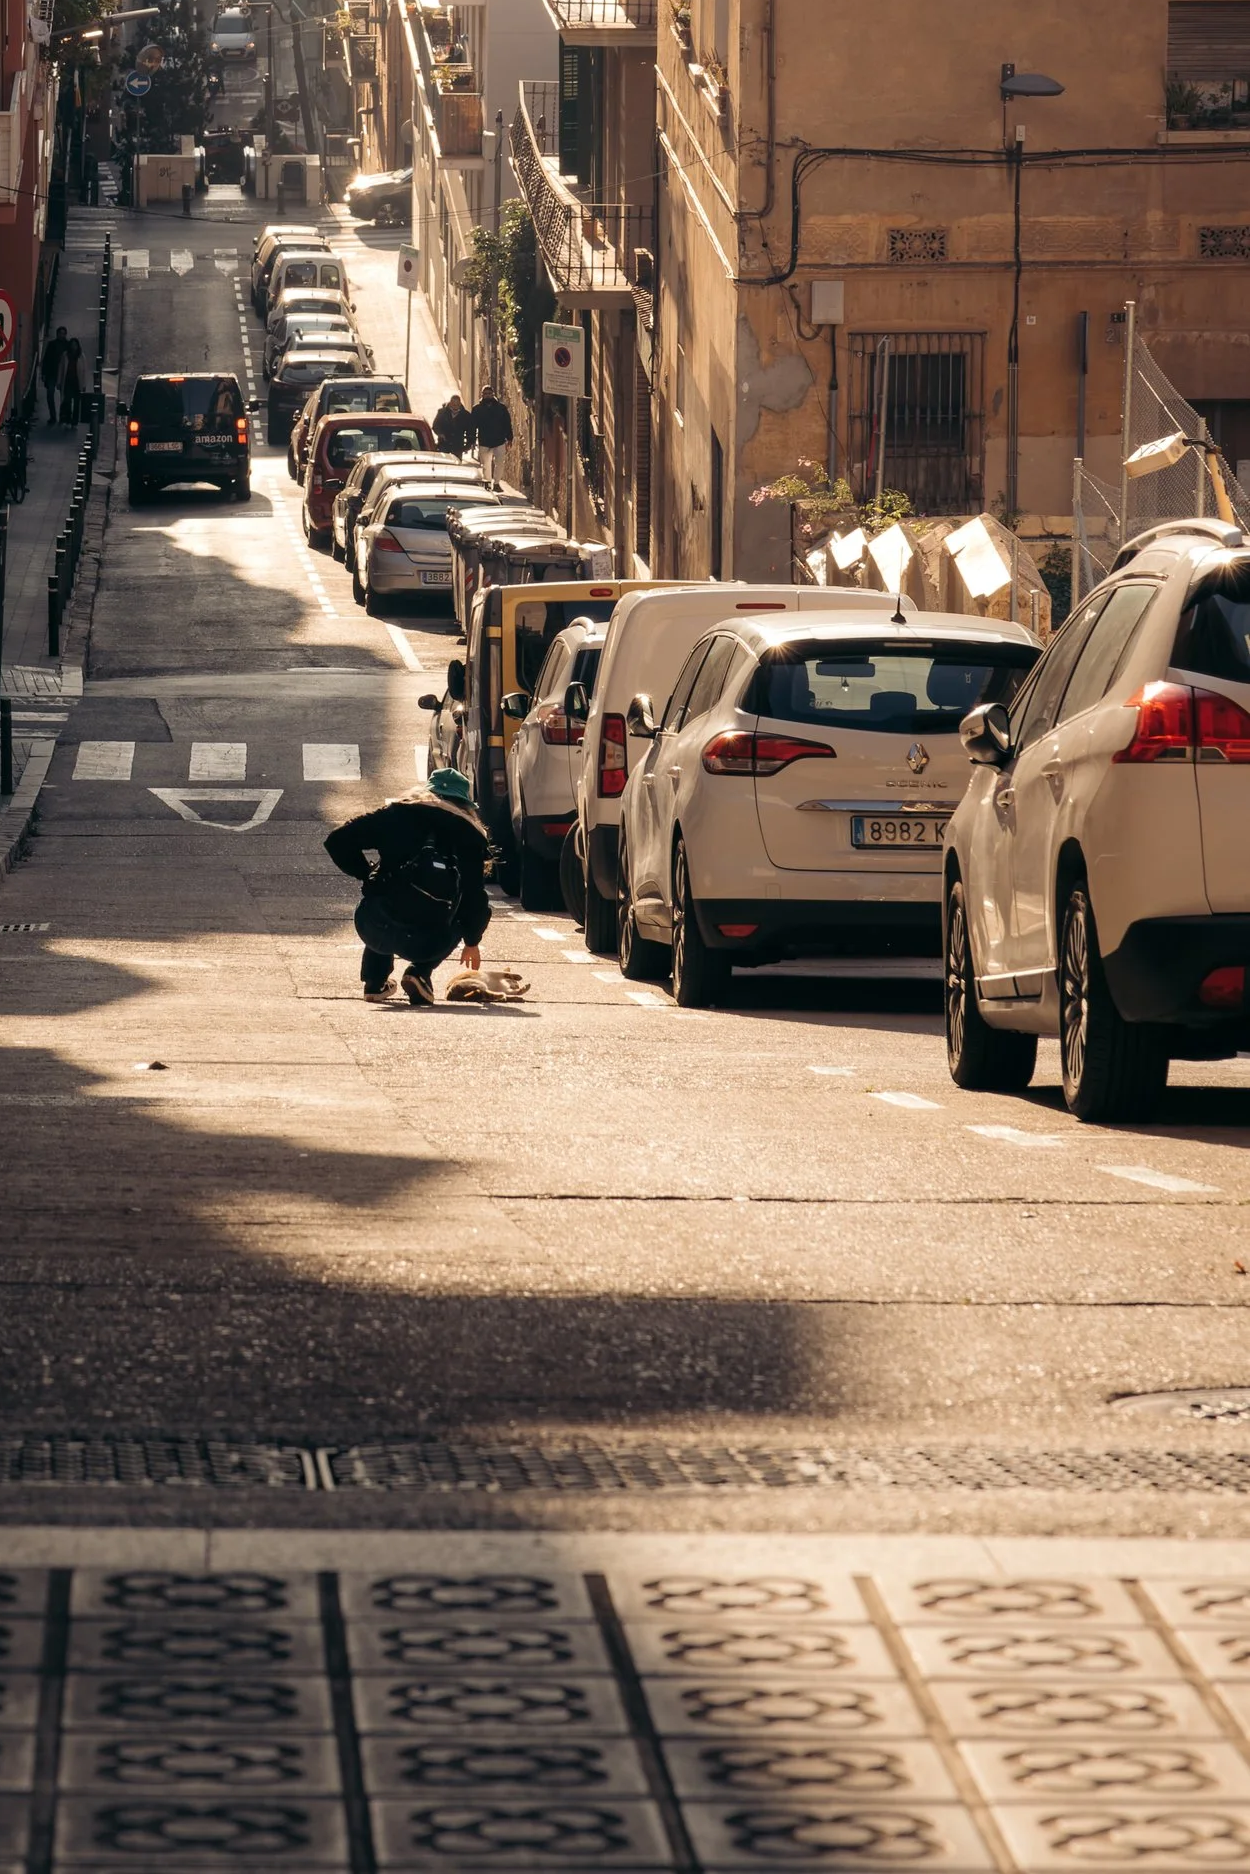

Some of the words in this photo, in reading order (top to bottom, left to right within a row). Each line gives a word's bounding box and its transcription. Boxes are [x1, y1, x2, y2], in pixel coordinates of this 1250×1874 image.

[195, 434, 233, 444] amazon
[427, 572, 450, 582] 3682
[885, 779, 948, 788] SCENIC
[870, 821, 926, 842] 8982
